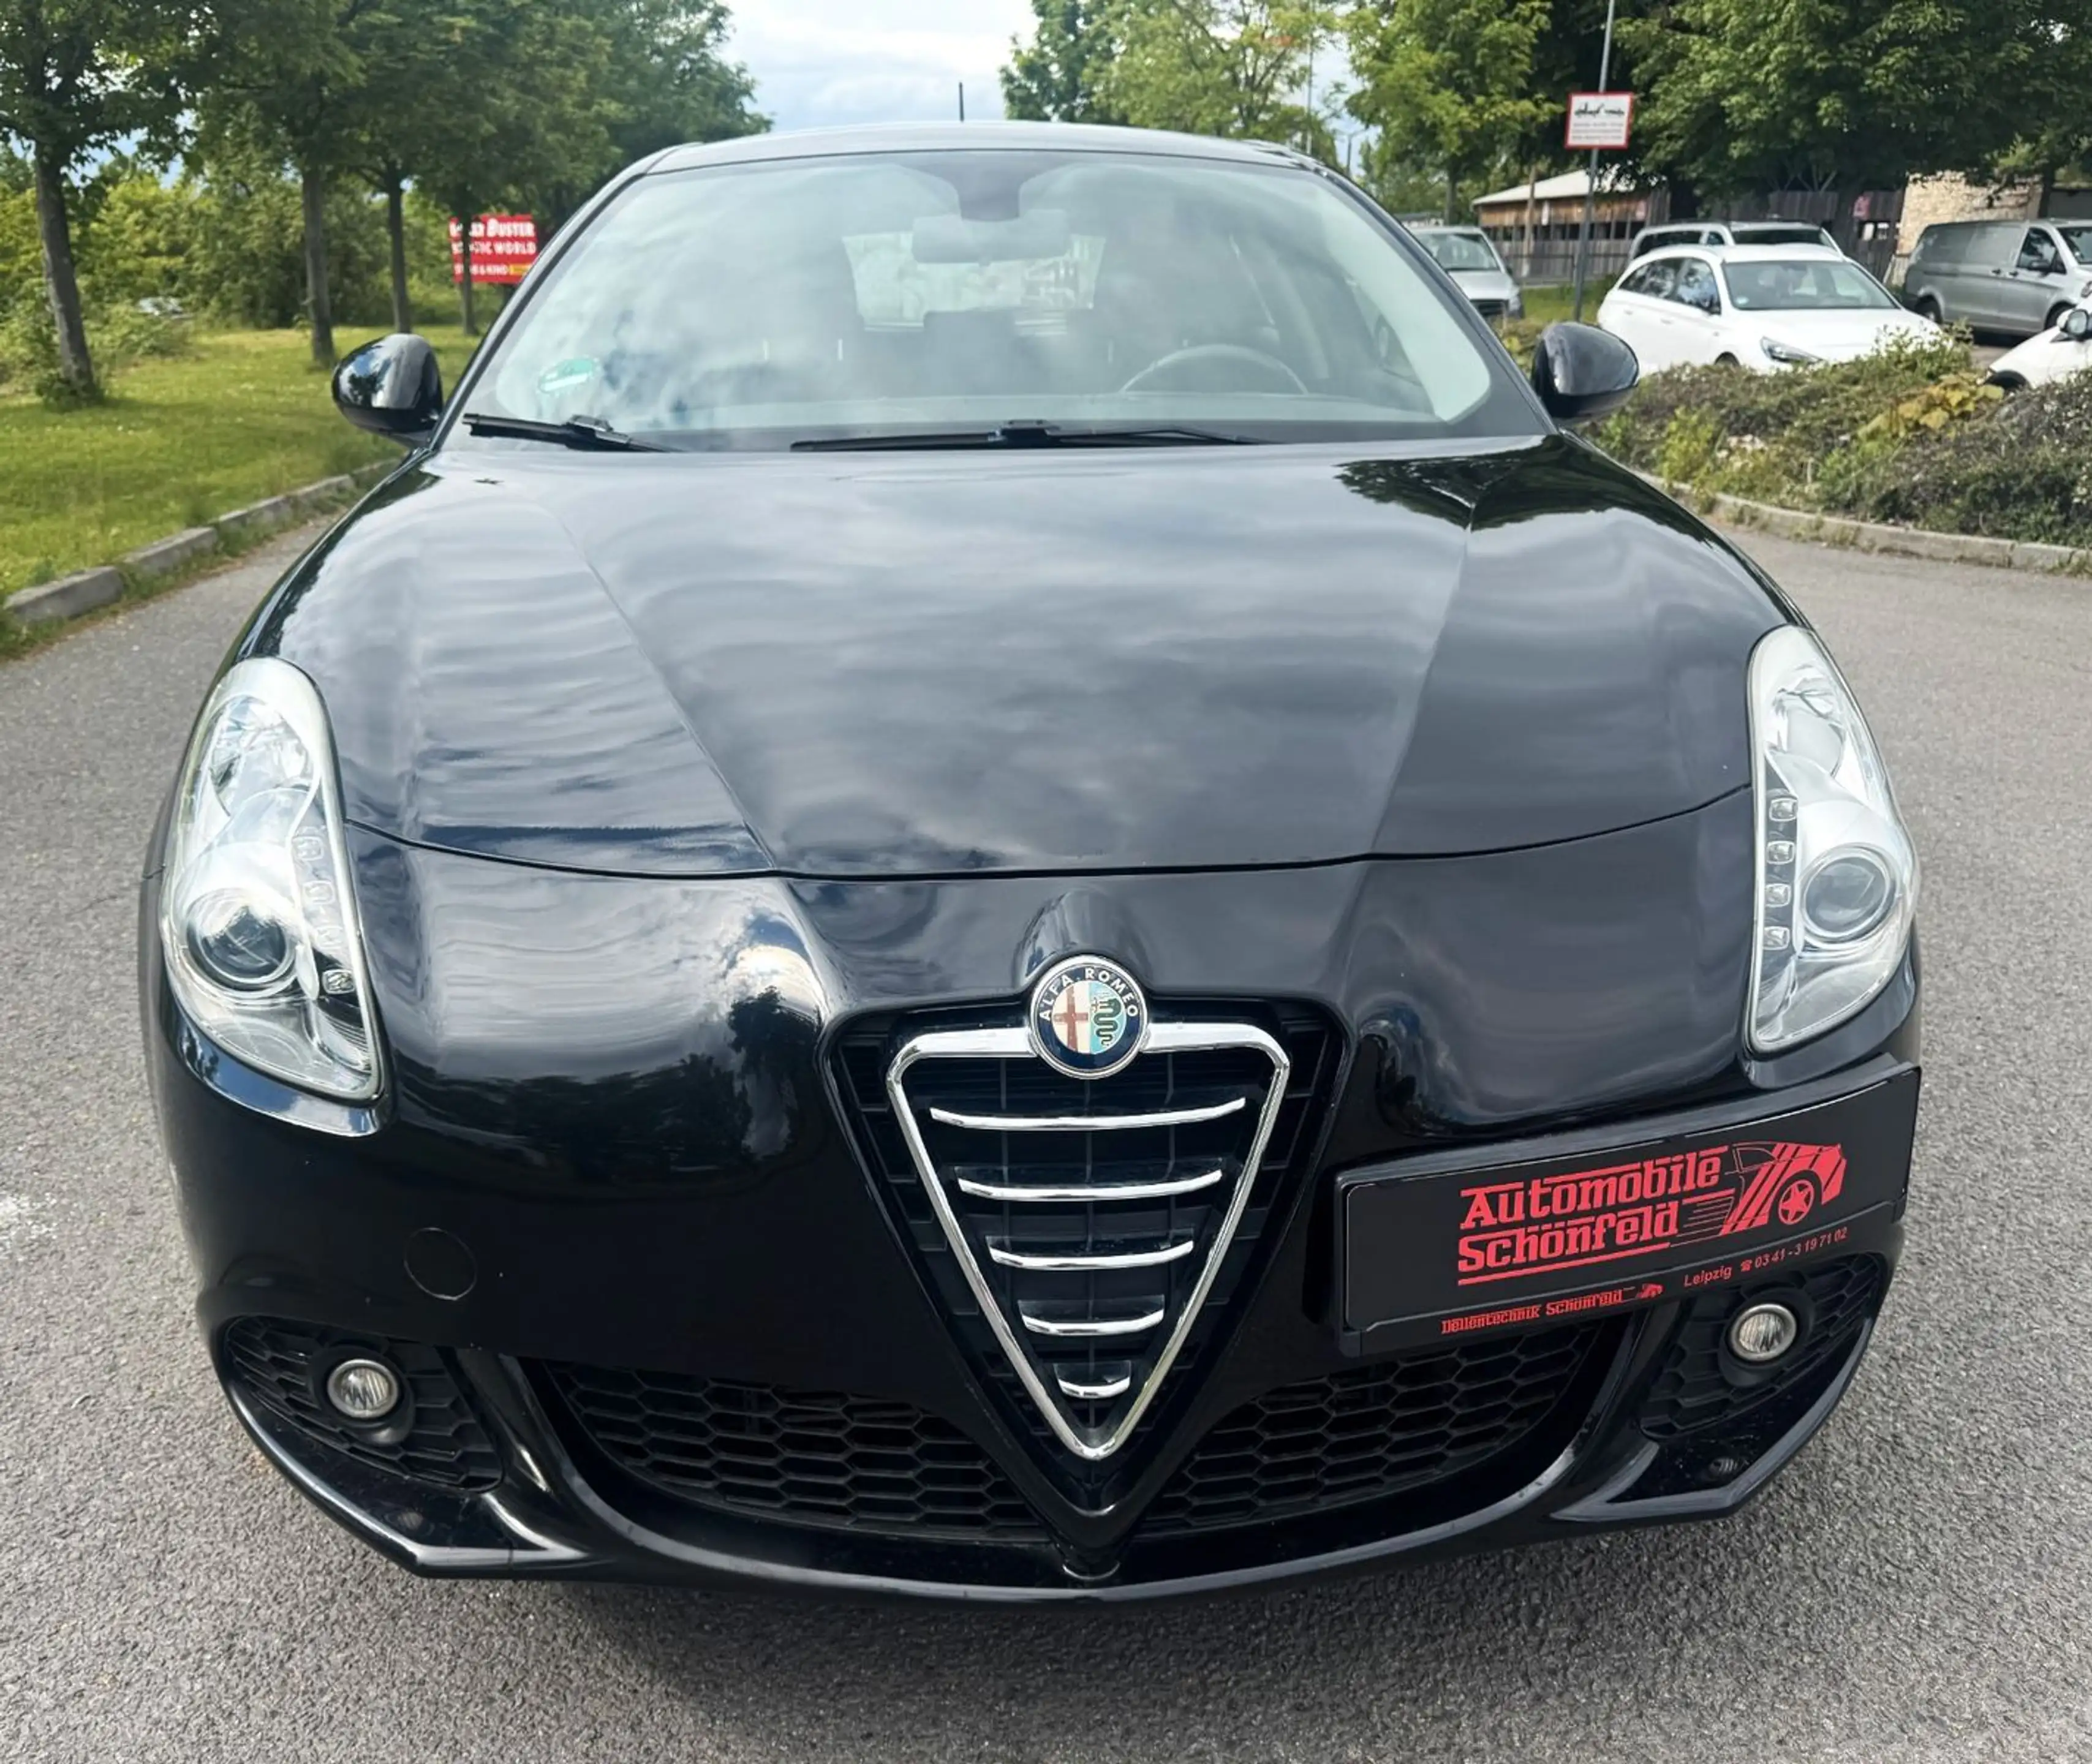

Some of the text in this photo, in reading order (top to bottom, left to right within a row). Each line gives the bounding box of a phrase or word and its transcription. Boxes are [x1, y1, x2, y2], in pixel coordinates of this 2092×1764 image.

[1040, 967, 1138, 1022] ALFA ROMEO
[1459, 1145, 1729, 1230] Automobile
[1457, 1200, 1679, 1272] Schönfeld
[1684, 1265, 1732, 1287] Leipzig
